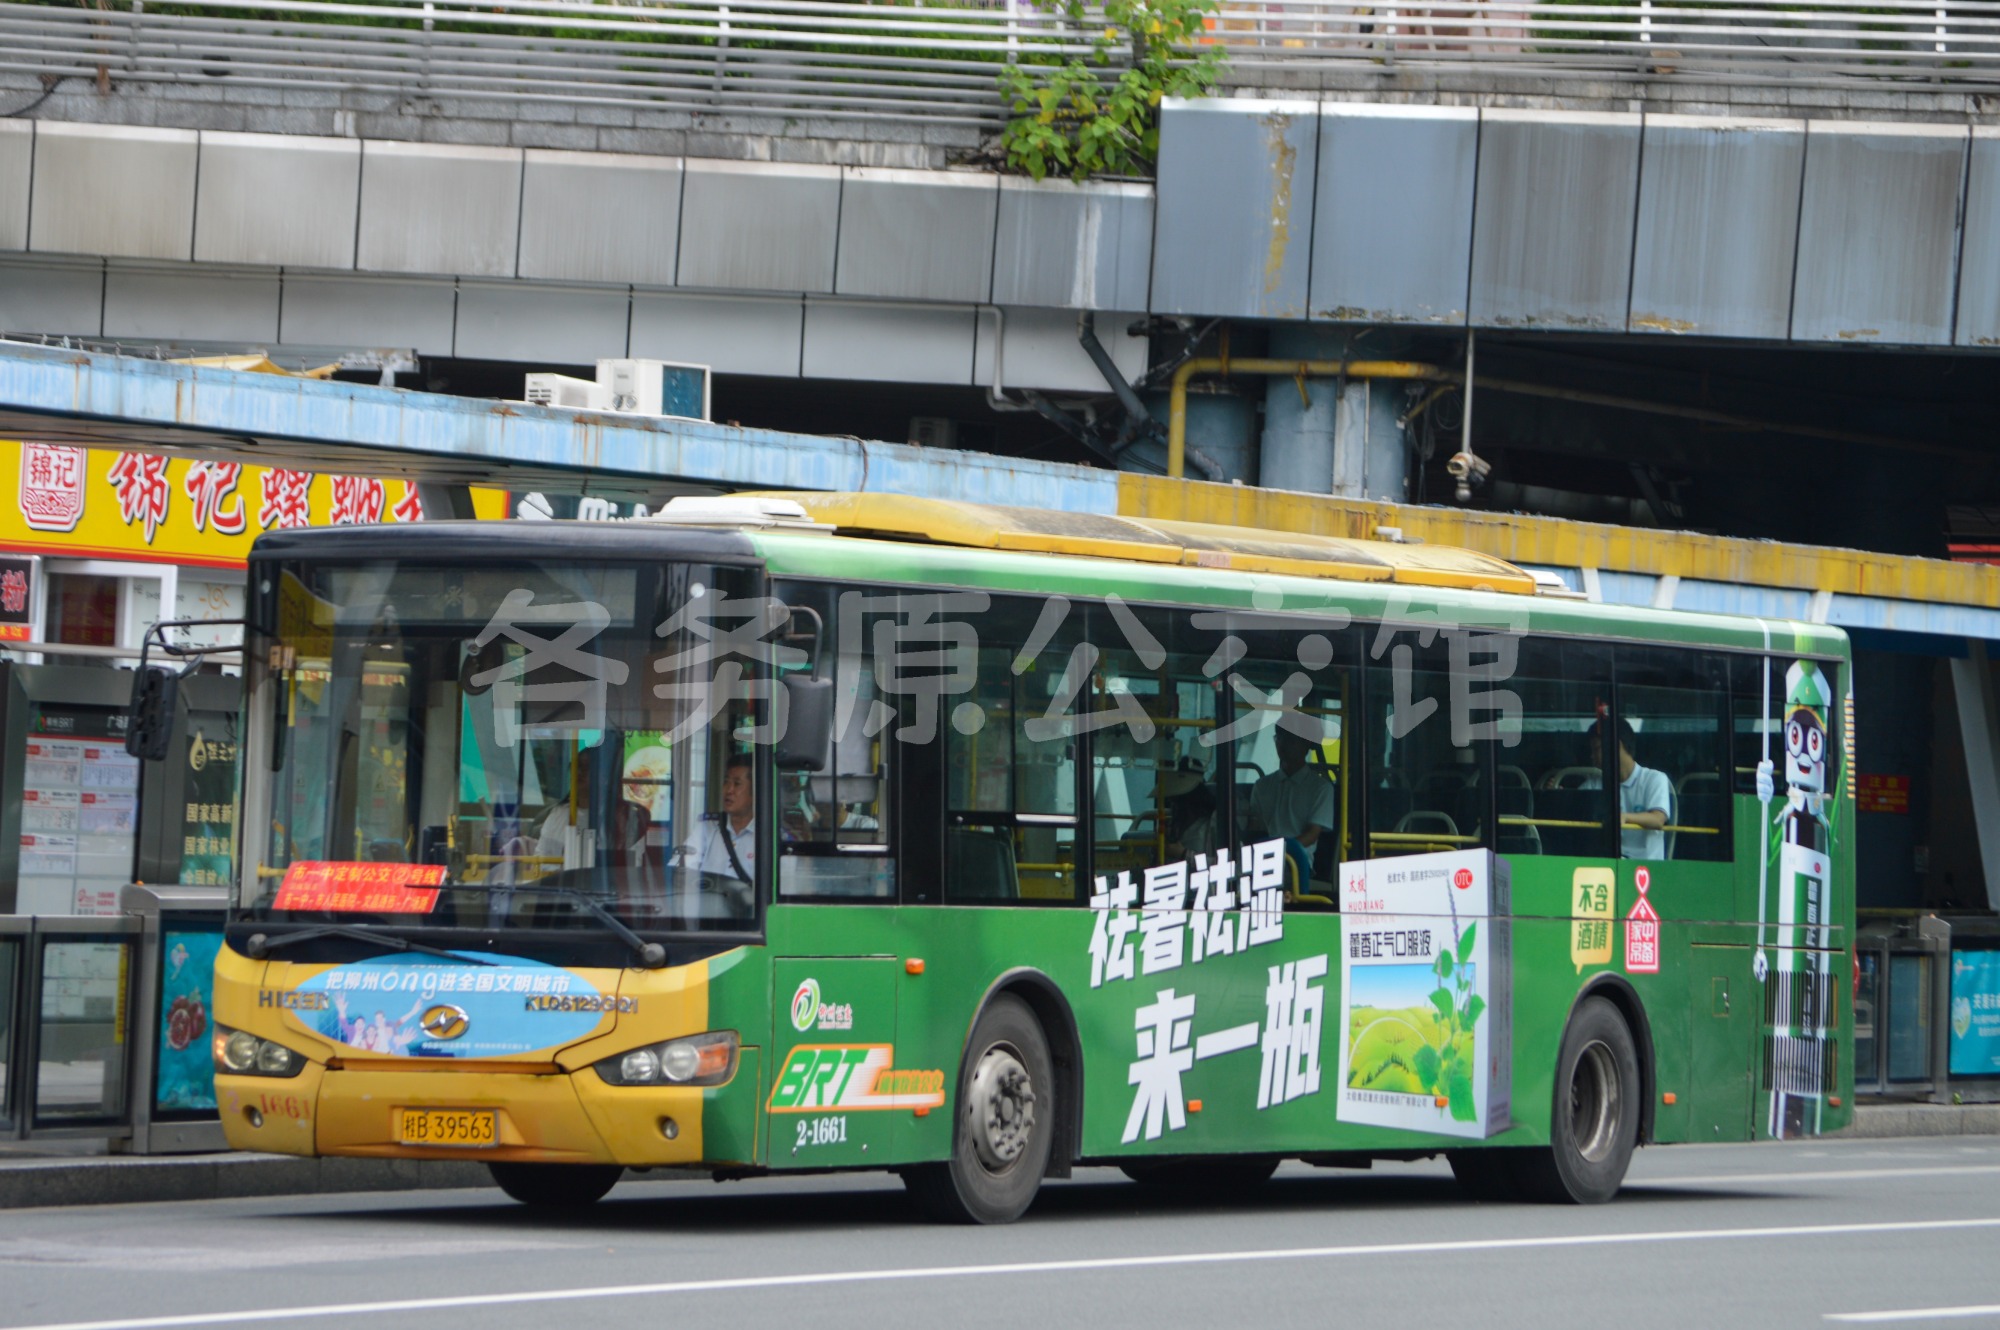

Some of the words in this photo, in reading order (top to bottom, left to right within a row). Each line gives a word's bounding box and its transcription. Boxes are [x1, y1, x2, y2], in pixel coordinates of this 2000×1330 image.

[30, 451, 76, 491] 锦记
[1455, 872, 1473, 886] OTC
[1089, 837, 1285, 989] 祛暑祛湿
[1348, 899, 1385, 912] HUOXIANG
[1350, 929, 1431, 958] 藿香正气口服液
[258, 990, 328, 1010] HIGER
[1121, 954, 1328, 1145] 来一瓶
[770, 1049, 870, 1107] BRT
[796, 1116, 847, 1146] 2-1661
